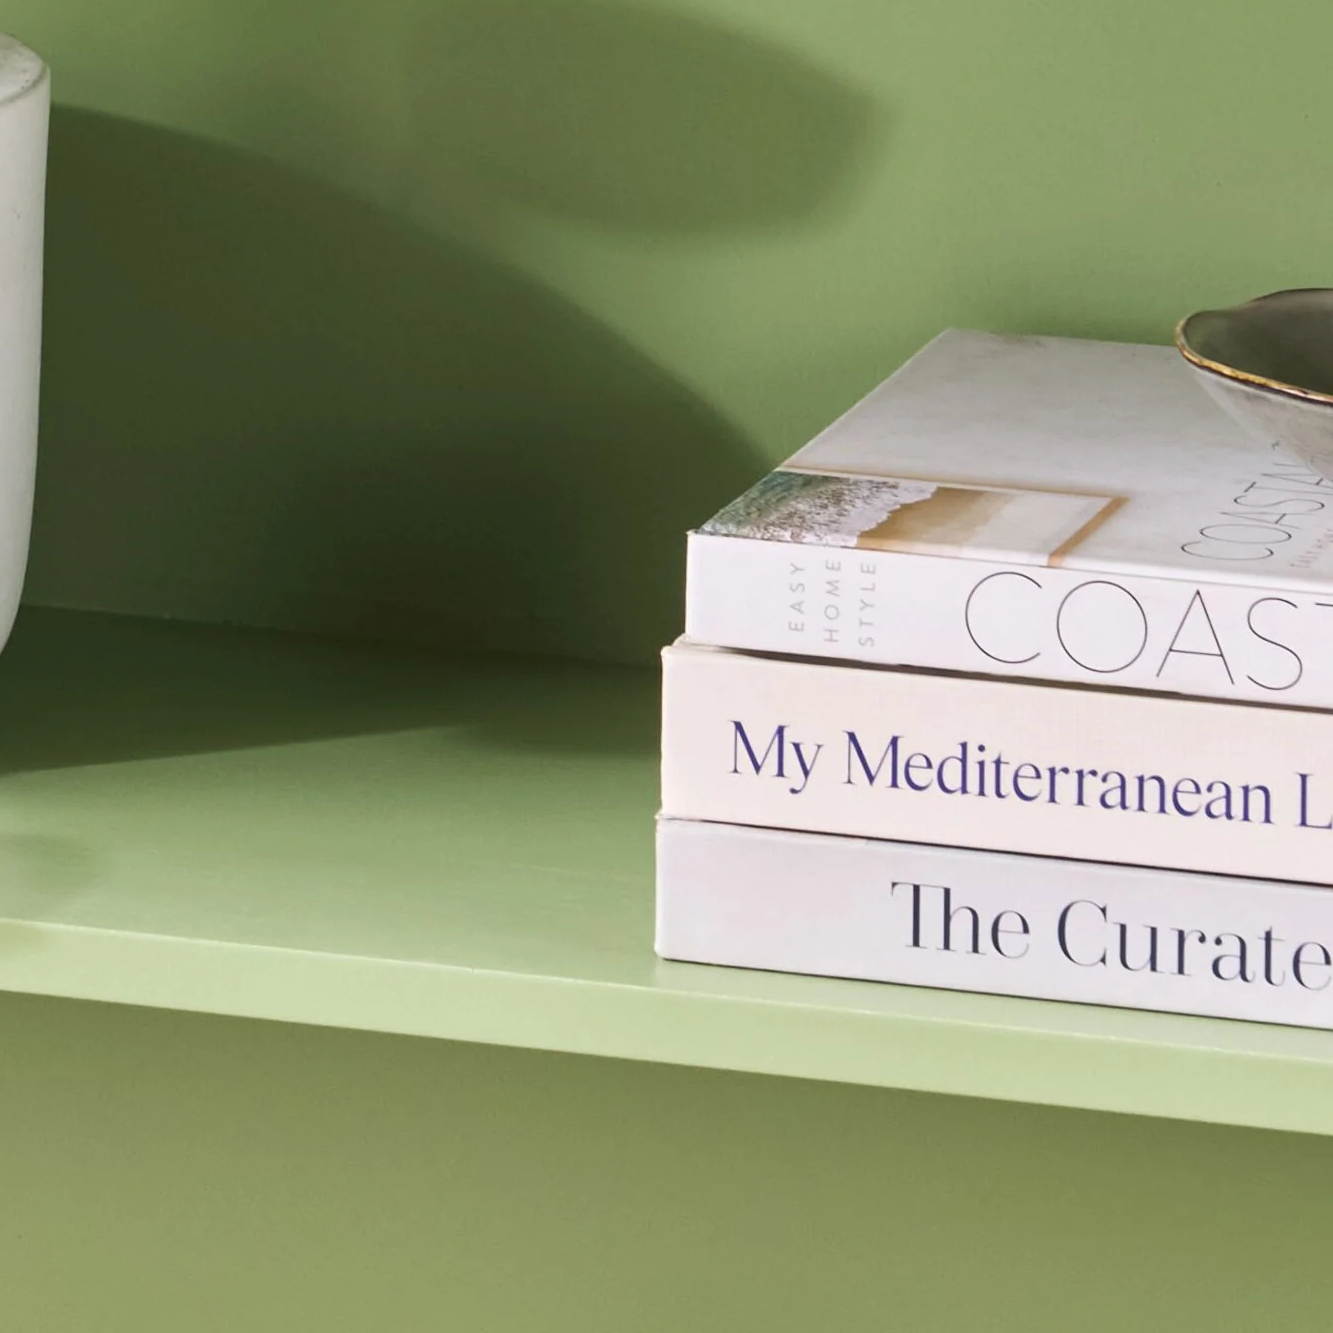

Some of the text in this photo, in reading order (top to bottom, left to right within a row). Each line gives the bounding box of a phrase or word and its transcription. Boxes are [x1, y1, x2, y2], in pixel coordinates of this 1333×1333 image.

[787, 562, 806, 633] EASY
[823, 559, 842, 643] HOME
[857, 563, 877, 648] STYLE
[965, 571, 1333, 691] COAS
[729, 719, 825, 795] My
[843, 729, 1276, 826] Mediterranean
[890, 881, 1333, 991] The Curate
